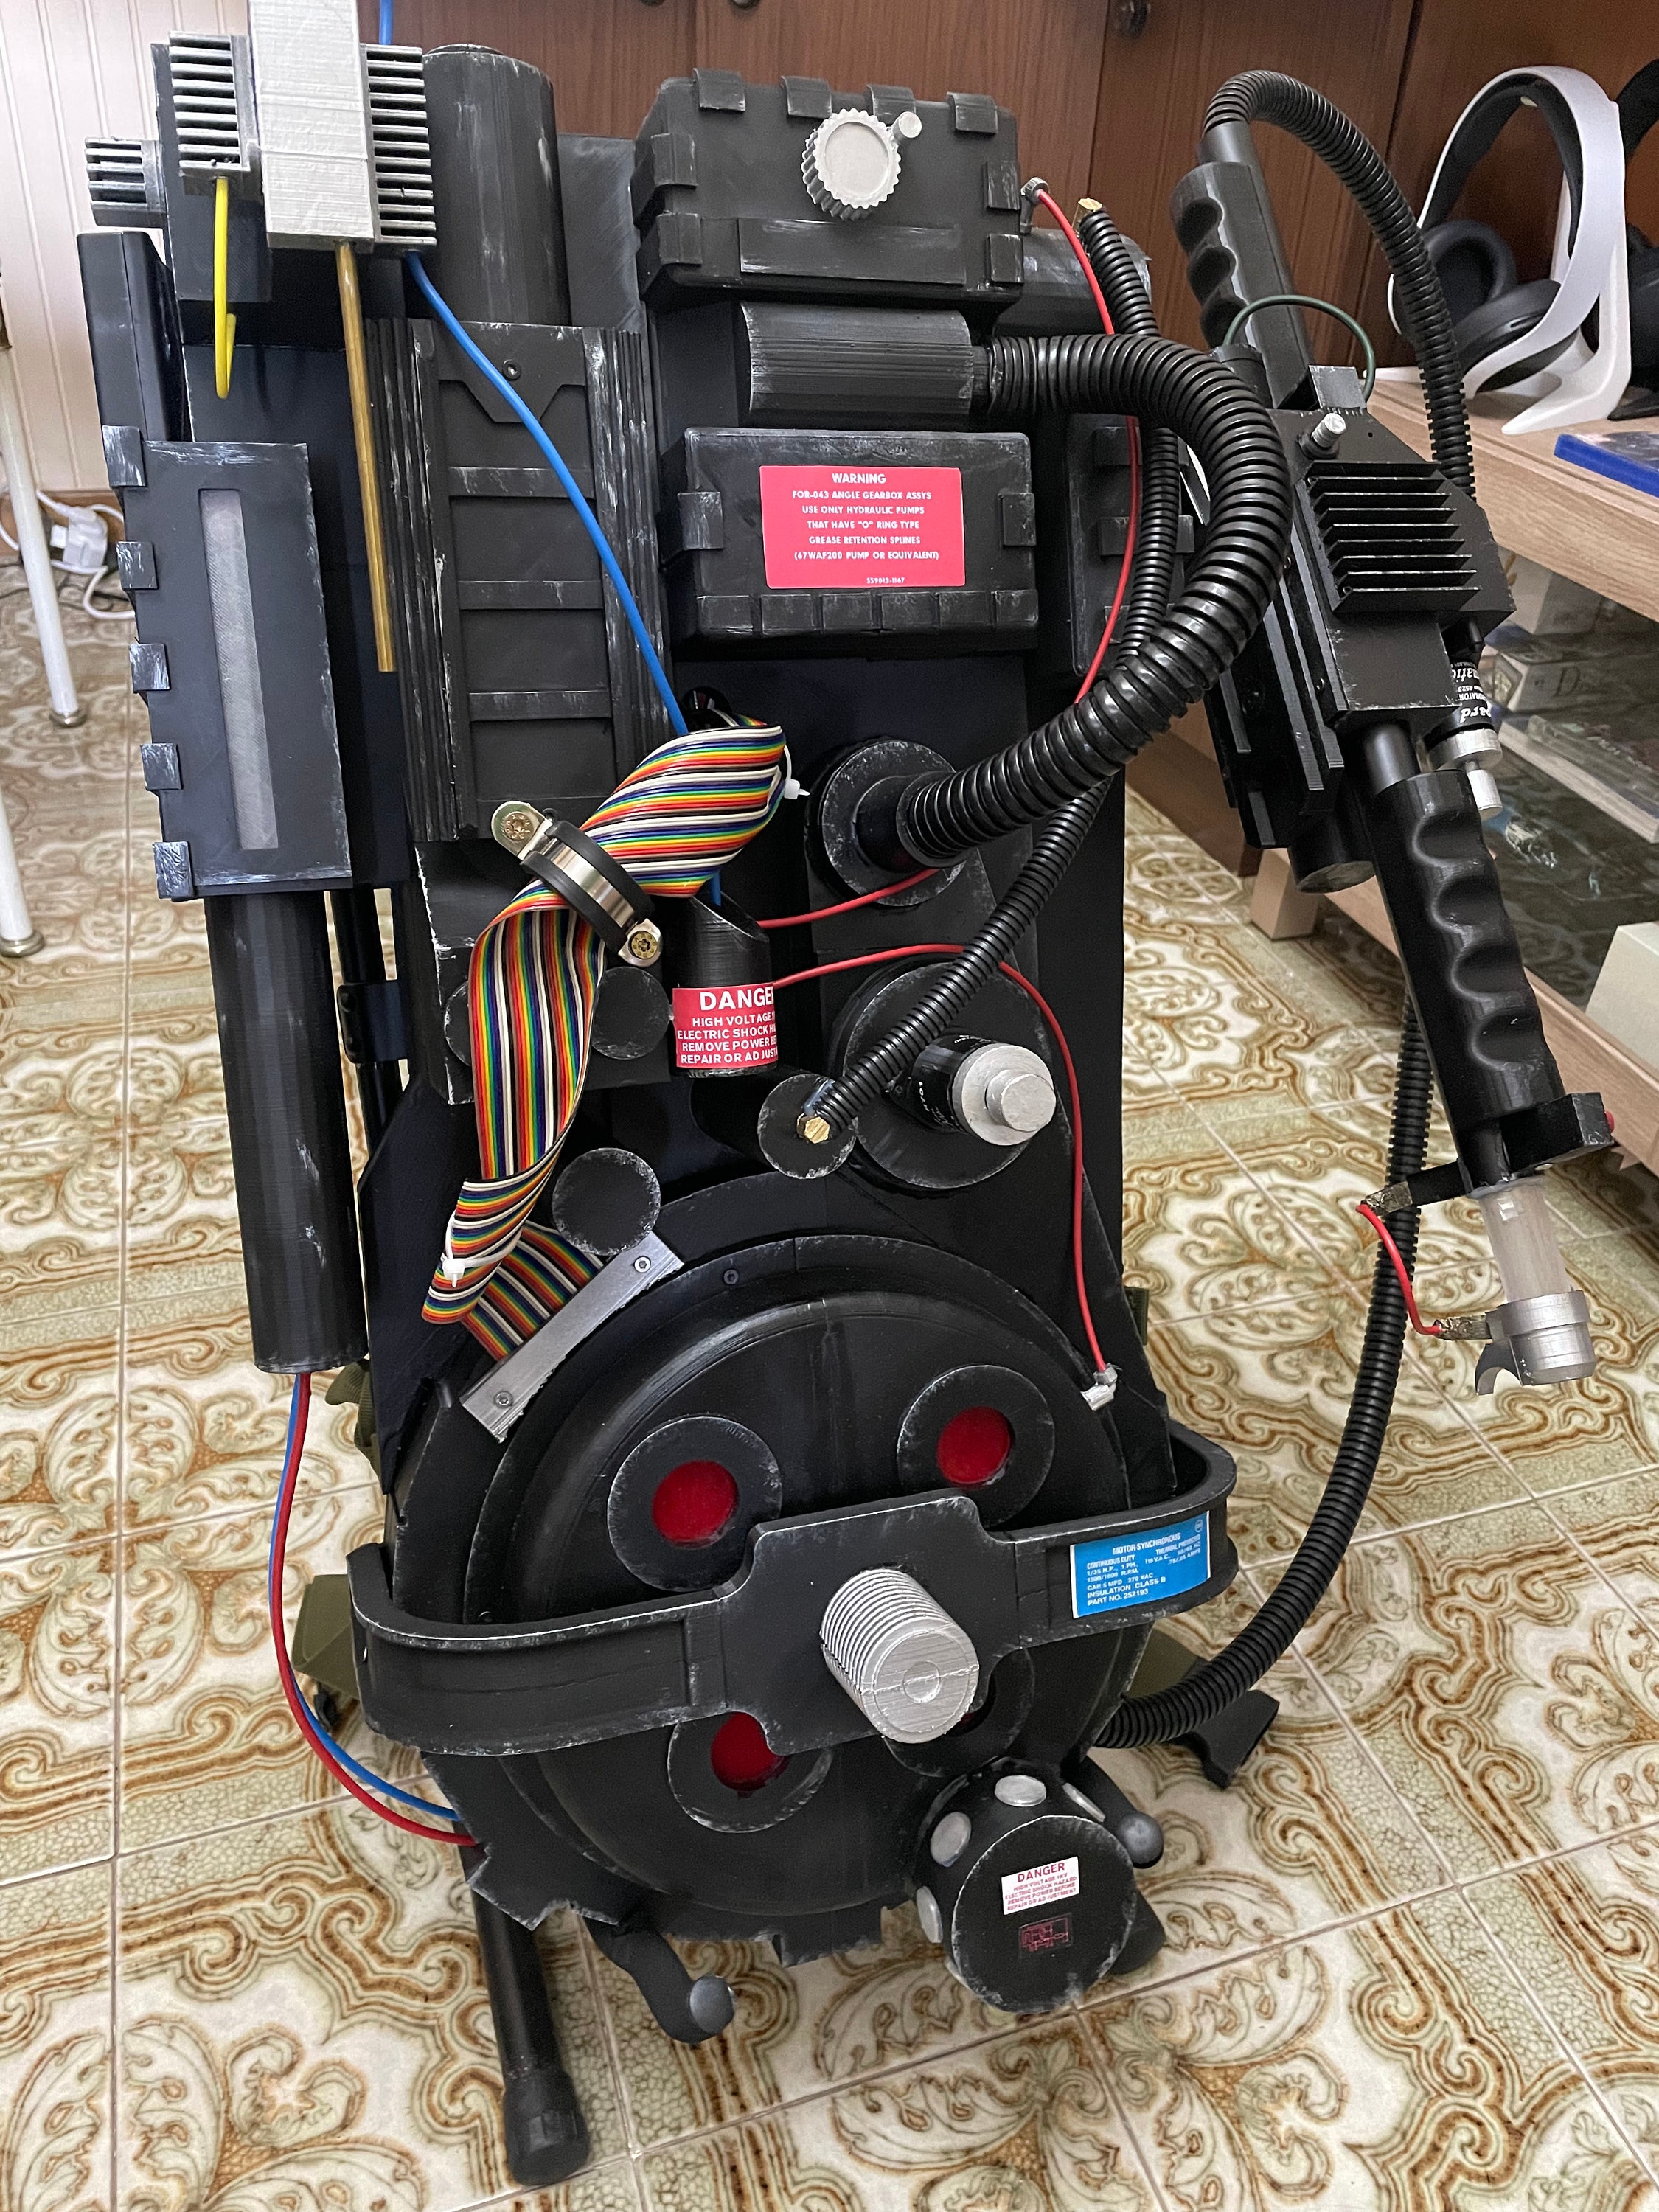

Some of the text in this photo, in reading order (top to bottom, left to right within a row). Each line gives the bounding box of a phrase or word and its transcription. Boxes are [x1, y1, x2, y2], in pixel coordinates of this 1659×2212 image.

[832, 473, 886, 484] WARNING
[792, 491, 829, 499] FOR-043
[832, 491, 860, 499] ANGLE
[906, 492, 931, 500] ASSYS
[809, 536, 841, 544] GREASE
[794, 552, 842, 560] (67WAF200
[888, 552, 939, 560] EQUIVALENT)
[692, 1018, 723, 1027] HIGH
[726, 1012, 771, 1026] VOLTAGE
[678, 1029, 730, 1040] ELECTRIC
[733, 1025, 768, 1037] SHOCK
[683, 1041, 730, 1051] REMOVE
[733, 1038, 769, 1050] POWER
[681, 1053, 721, 1063] REPAIR
[724, 1053, 742, 1062] OR
[1087, 1554, 1135, 1570] CONTINUOUS DUTY
[1088, 1584, 1130, 1599] INSULATION
[1135, 1579, 1158, 1589] CLASS
[1088, 1597, 1107, 1606] PART
[1124, 1588, 1148, 1599] 252193
[1018, 1863, 1065, 1882] DANGER
[1005, 1877, 1077, 1899] ELECTRIC SHOCK HAZARD
[1029, 1876, 1055, 1887] VOLTAGE
[1008, 1882, 1075, 1905] REMOVE POWER BEFORE
[1008, 1902, 1027, 1910] REPAIR
